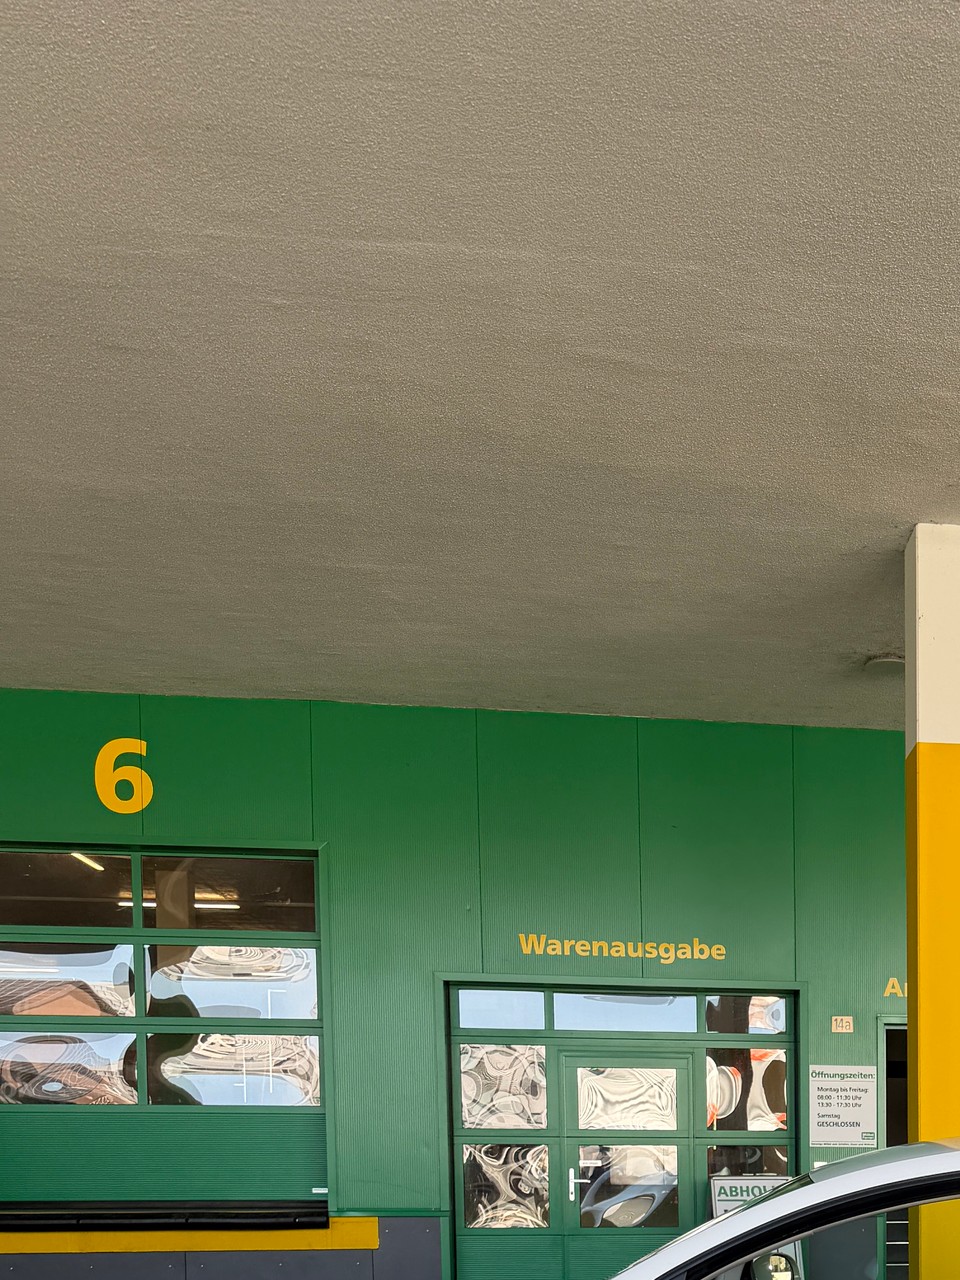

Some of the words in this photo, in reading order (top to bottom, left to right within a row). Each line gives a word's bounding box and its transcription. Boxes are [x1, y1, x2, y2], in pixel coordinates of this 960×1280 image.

[94, 737, 154, 814] 6
[518, 933, 726, 964] Warenausgabe
[833, 1018, 851, 1031] 14a
[811, 1071, 875, 1080] Öffnungszeiten:
[817, 1086, 840, 1094] Montag
[817, 1112, 841, 1120] Samstag
